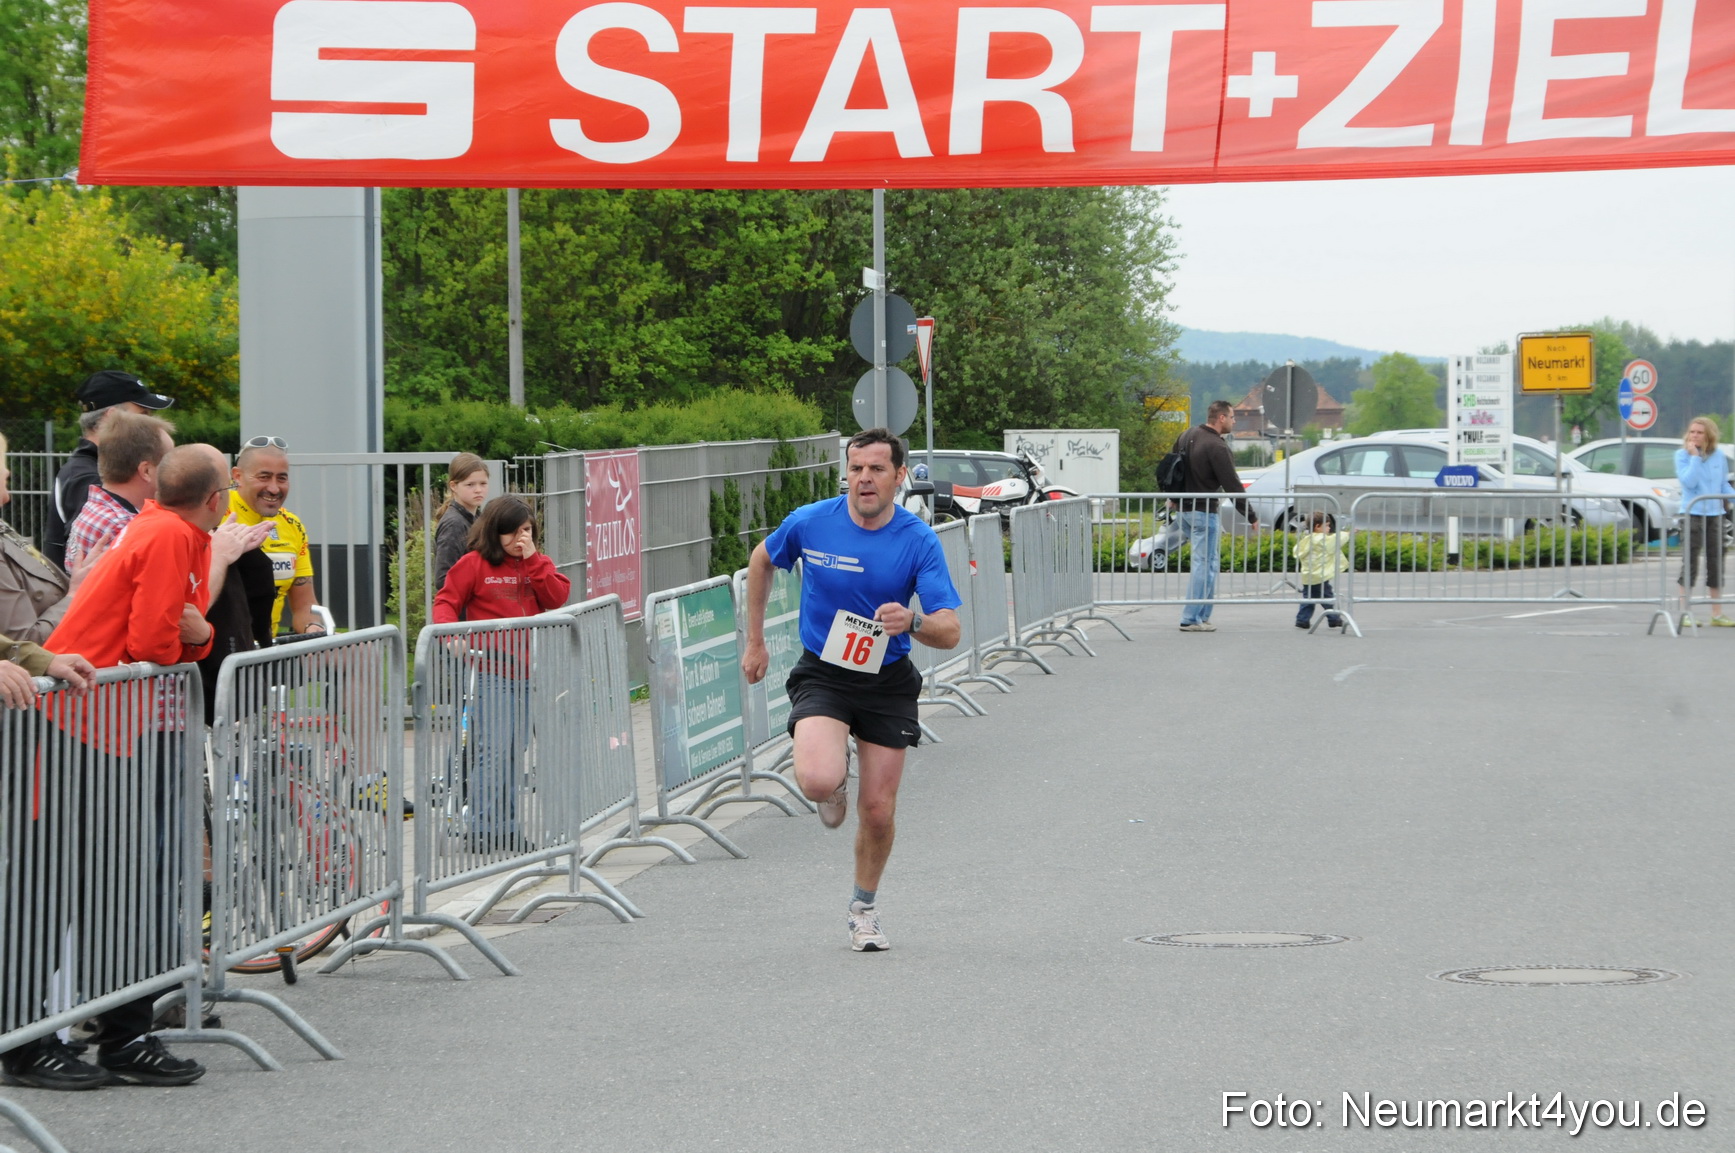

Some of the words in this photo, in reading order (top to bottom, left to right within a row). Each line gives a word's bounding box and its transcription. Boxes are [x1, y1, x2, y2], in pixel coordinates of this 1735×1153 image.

[1546, 344, 1567, 352] Nach
[1527, 355, 1585, 369] Neumarkt
[1632, 369, 1649, 384] 60
[1443, 475, 1475, 486] VOLVO
[596, 517, 636, 561] ZEITLOS
[844, 621, 872, 635] WERBUNG
[845, 615, 873, 630] MEYER
[842, 631, 875, 666] 16
